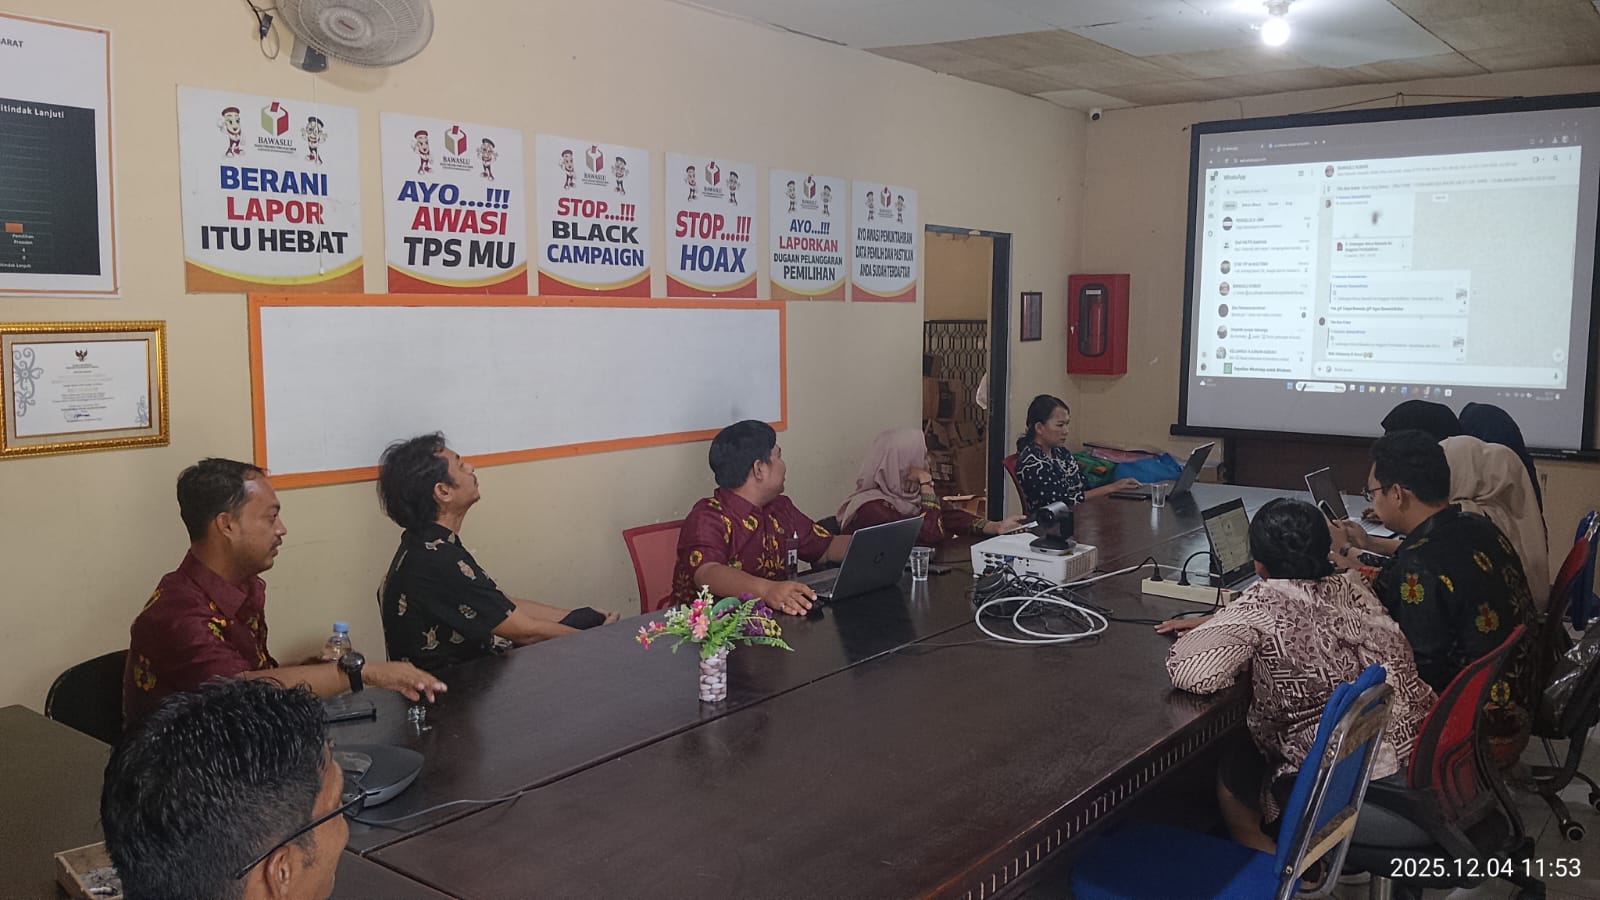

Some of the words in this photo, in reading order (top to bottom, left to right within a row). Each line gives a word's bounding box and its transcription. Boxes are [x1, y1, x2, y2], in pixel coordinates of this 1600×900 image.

[34, 107, 65, 119] Lanjuti
[258, 137, 293, 148] BAWASLU
[220, 165, 328, 196] BERANI
[397, 180, 511, 210] AYO...!!!
[227, 196, 325, 225] LAPOR
[411, 205, 508, 236] AWASI
[557, 197, 636, 222] STOP...!!!
[552, 220, 640, 245] BLACK
[675, 210, 752, 243] STOP...!!!
[790, 218, 831, 235] AYO...!!!
[201, 225, 251, 251] ITU
[258, 228, 349, 254] HEBAT
[779, 235, 838, 252] LAPORKAN
[403, 236, 461, 267] TPS
[468, 239, 516, 269] MU
[547, 243, 645, 268] CAMPAIGN
[680, 243, 747, 274] HOAX
[773, 253, 800, 263] DUGAAN
[800, 255, 843, 266] PELANGGARAN
[783, 265, 836, 281] PEMILIHAN
